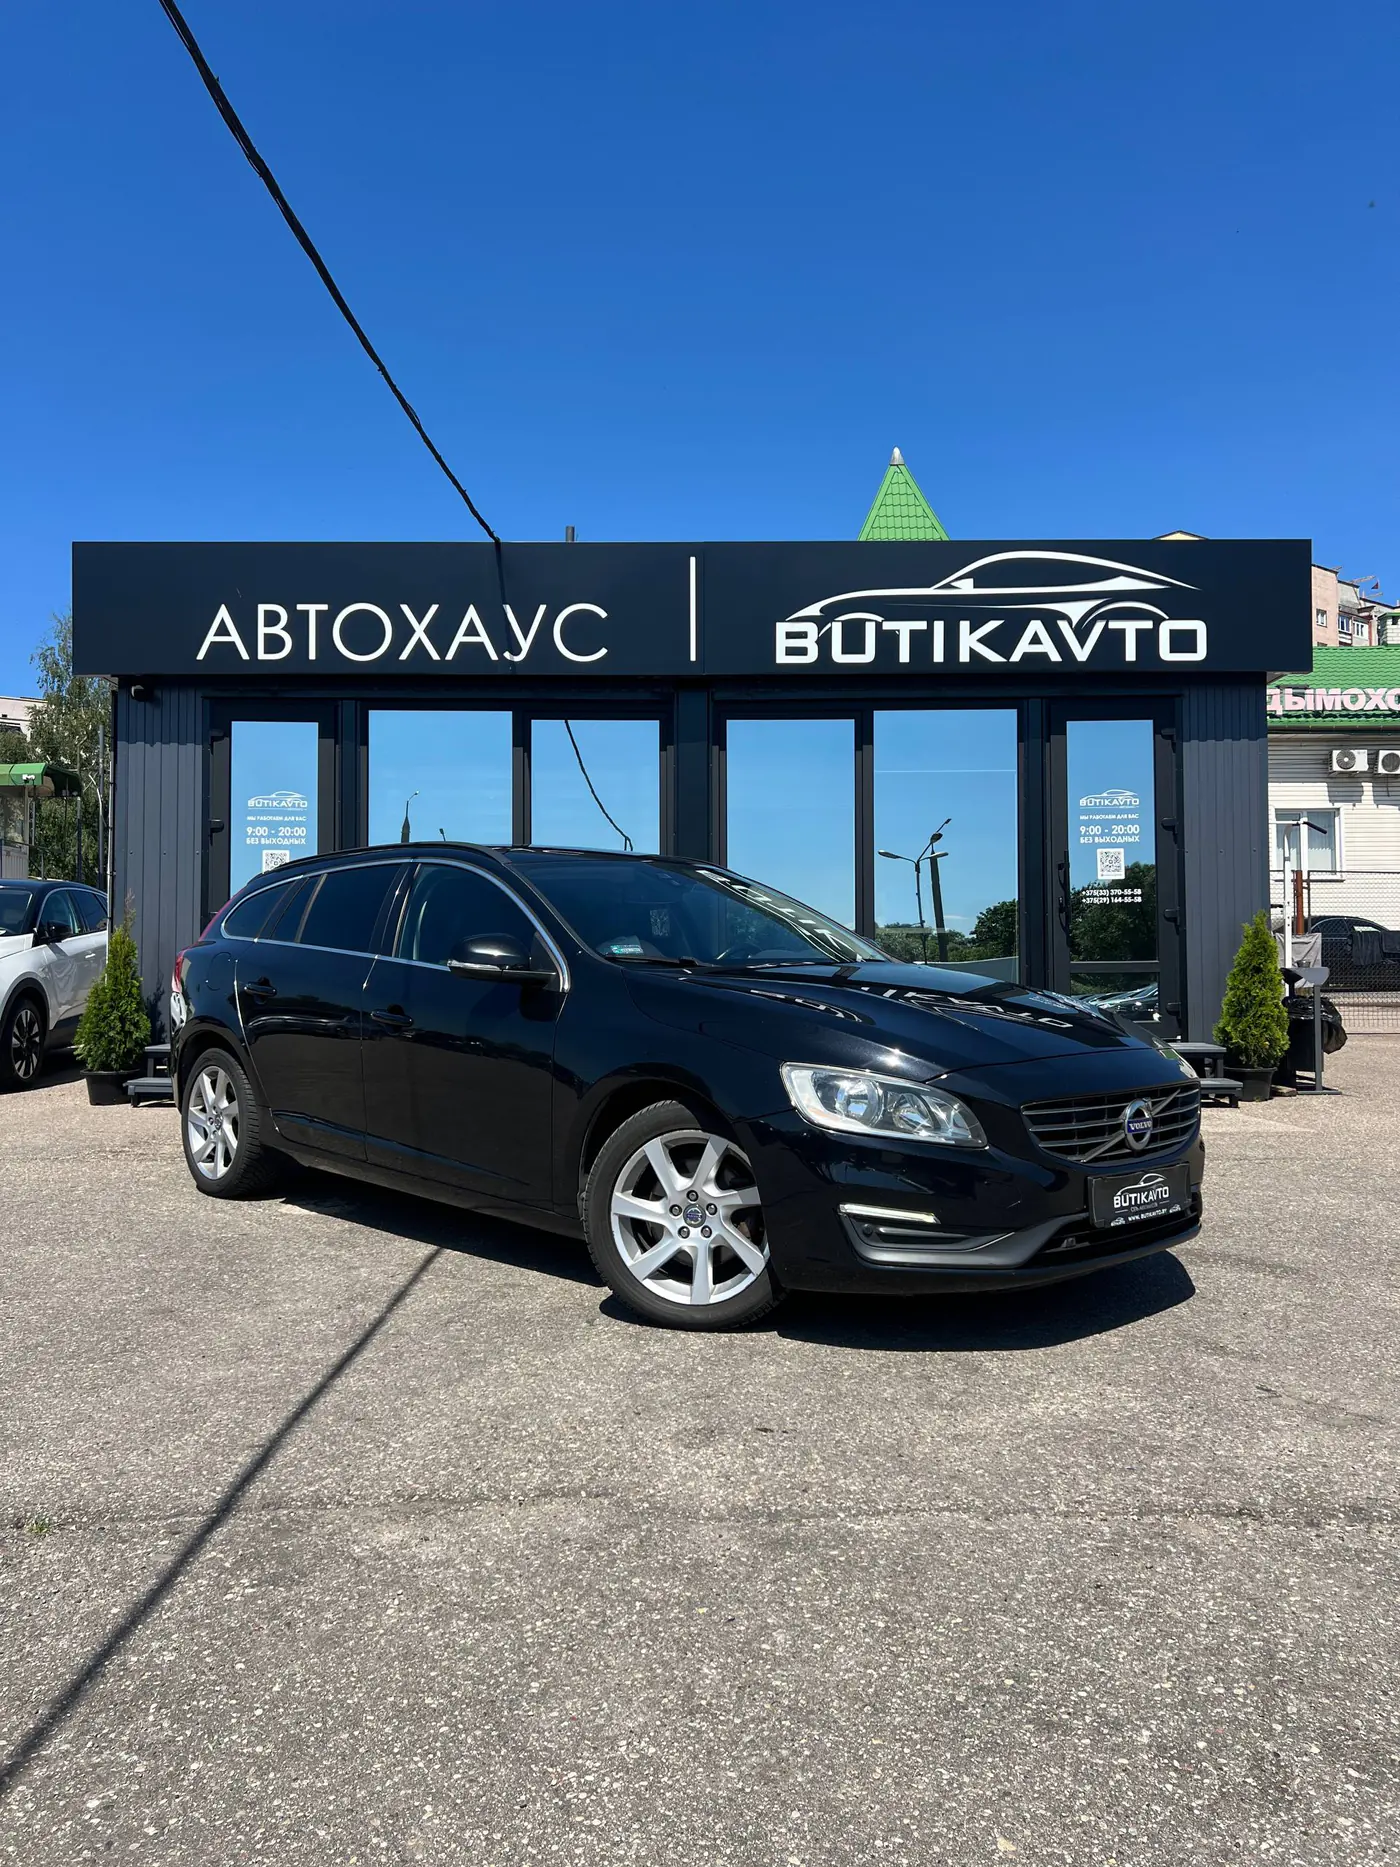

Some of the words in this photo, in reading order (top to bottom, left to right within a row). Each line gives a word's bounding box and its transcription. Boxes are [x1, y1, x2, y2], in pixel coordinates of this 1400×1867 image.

[196, 602, 609, 663] АВТОХАУС
[775, 619, 1208, 664] BUTIKAVTO
[247, 799, 308, 808] BUTIKAVTO
[1080, 798, 1139, 806] BUTIKAVTO
[246, 827, 268, 836] 9:00
[278, 826, 306, 836] 20:00
[1080, 826, 1101, 835] 9:00
[1111, 824, 1140, 834] 20:00
[246, 837, 259, 845] БЕЗ
[260, 837, 306, 845] ВЫХОДНЫХ
[1080, 836, 1093, 844] БЕЗ
[1094, 835, 1140, 843] ВЫХОДНЫХ
[1129, 1121, 1152, 1130] VOLVO
[1113, 1186, 1170, 1208] BUTIKAVTO
